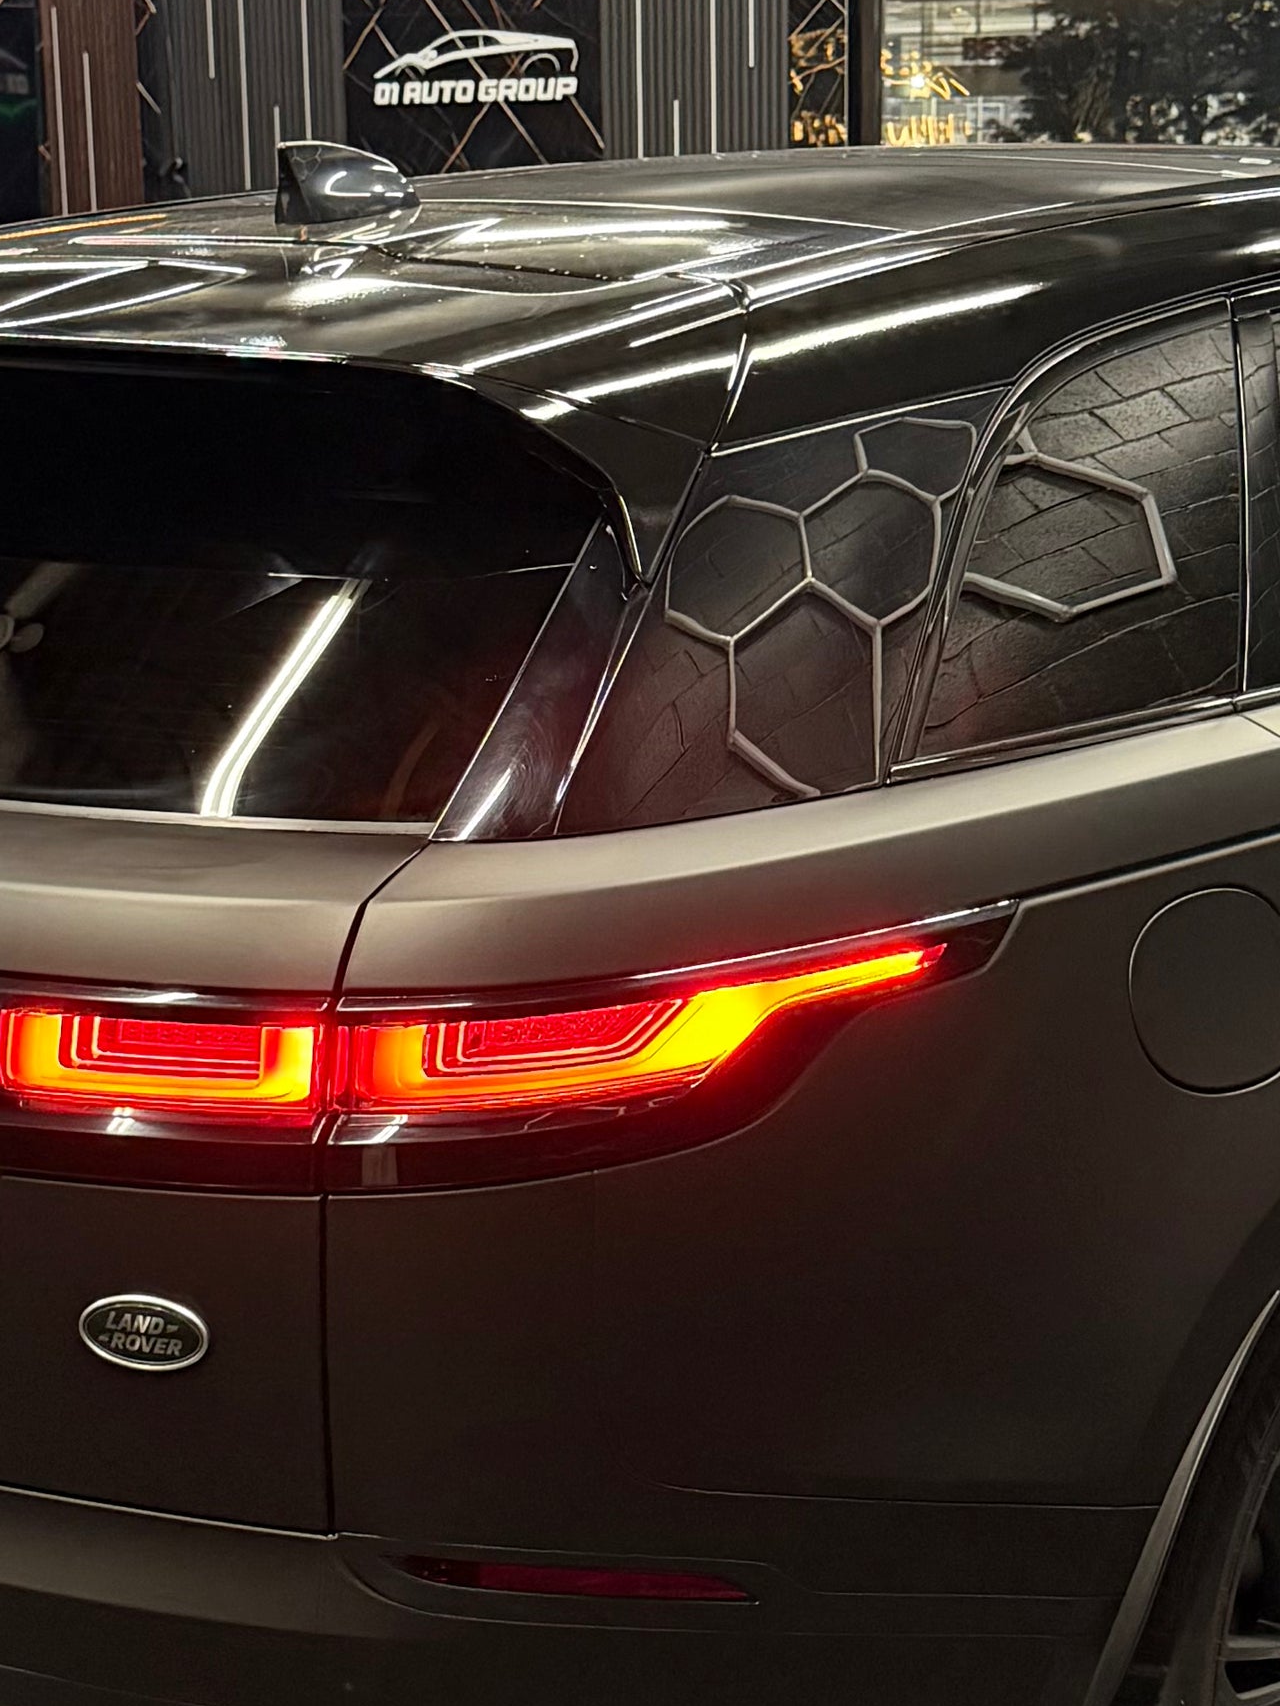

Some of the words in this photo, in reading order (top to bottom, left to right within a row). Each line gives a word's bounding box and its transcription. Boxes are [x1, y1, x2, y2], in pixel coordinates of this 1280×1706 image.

[373, 81, 400, 106] 01
[403, 79, 475, 105] AUTO
[477, 76, 578, 103] GROUP
[105, 1311, 165, 1335] LAND
[110, 1332, 183, 1357] ROVER
